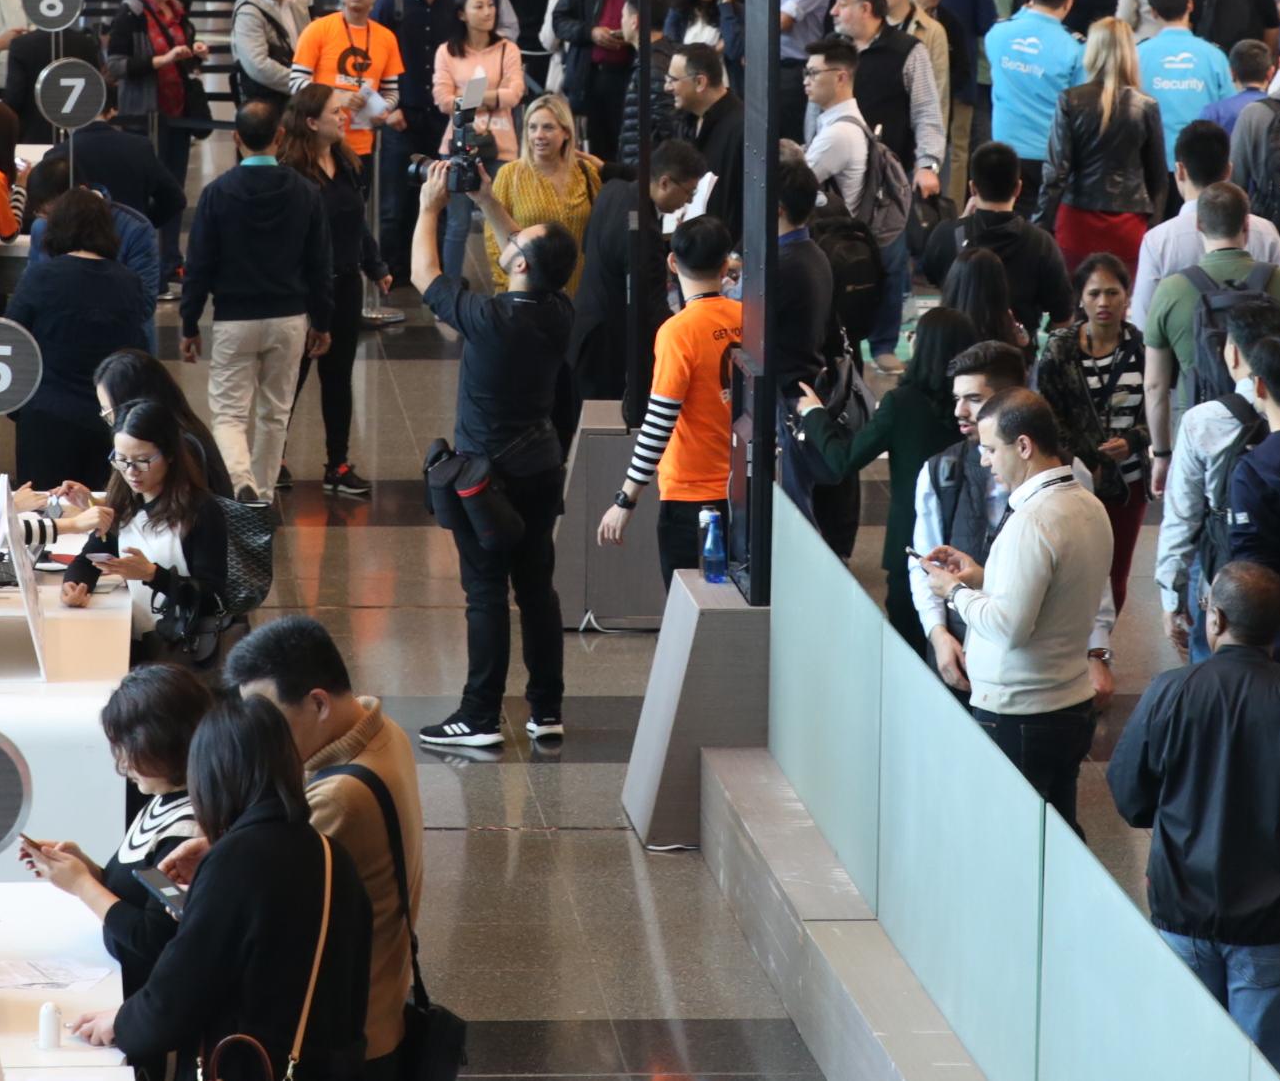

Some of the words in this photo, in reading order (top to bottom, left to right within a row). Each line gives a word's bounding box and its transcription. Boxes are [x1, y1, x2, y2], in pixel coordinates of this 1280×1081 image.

[1001, 56, 1045, 79] Security
[1153, 76, 1204, 91] Security
[59, 77, 86, 114] 7
